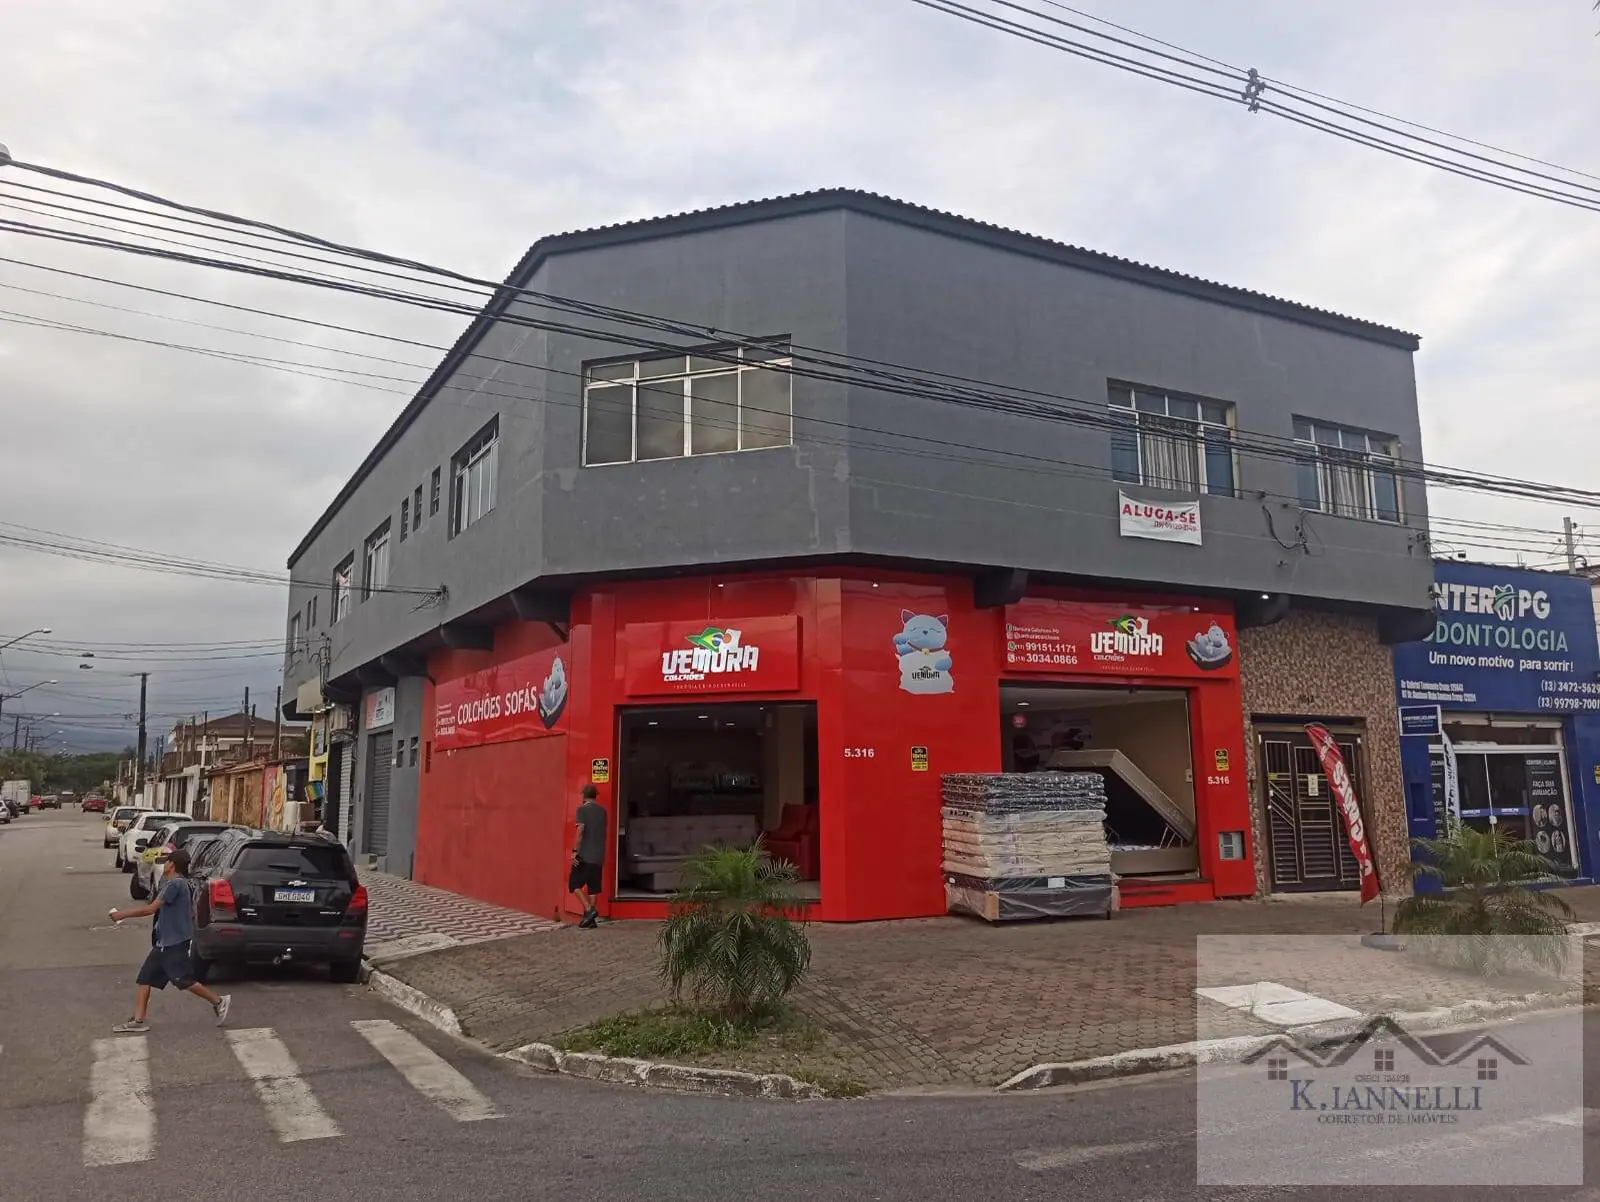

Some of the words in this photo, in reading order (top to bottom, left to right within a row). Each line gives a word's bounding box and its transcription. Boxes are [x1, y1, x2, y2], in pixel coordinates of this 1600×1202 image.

[1122, 503, 1197, 524] ALUGA-SE
[1518, 589, 1550, 620] PG
[1025, 642, 1076, 653] 99151.1171
[1026, 653, 1078, 665] 3034.0866
[1429, 651, 1447, 665] Um
[1450, 655, 1476, 667] novo
[1478, 656, 1515, 668] motivo
[1519, 659, 1542, 672] para
[1543, 660, 1574, 673] sorrir!
[1541, 679, 1557, 693] (13)
[457, 693, 501, 725] COLCHÕES
[504, 682, 538, 717] SOFÁS
[1537, 696, 1553, 709] (13)
[843, 748, 875, 758] 5.316
[1207, 776, 1230, 785] 5.316
